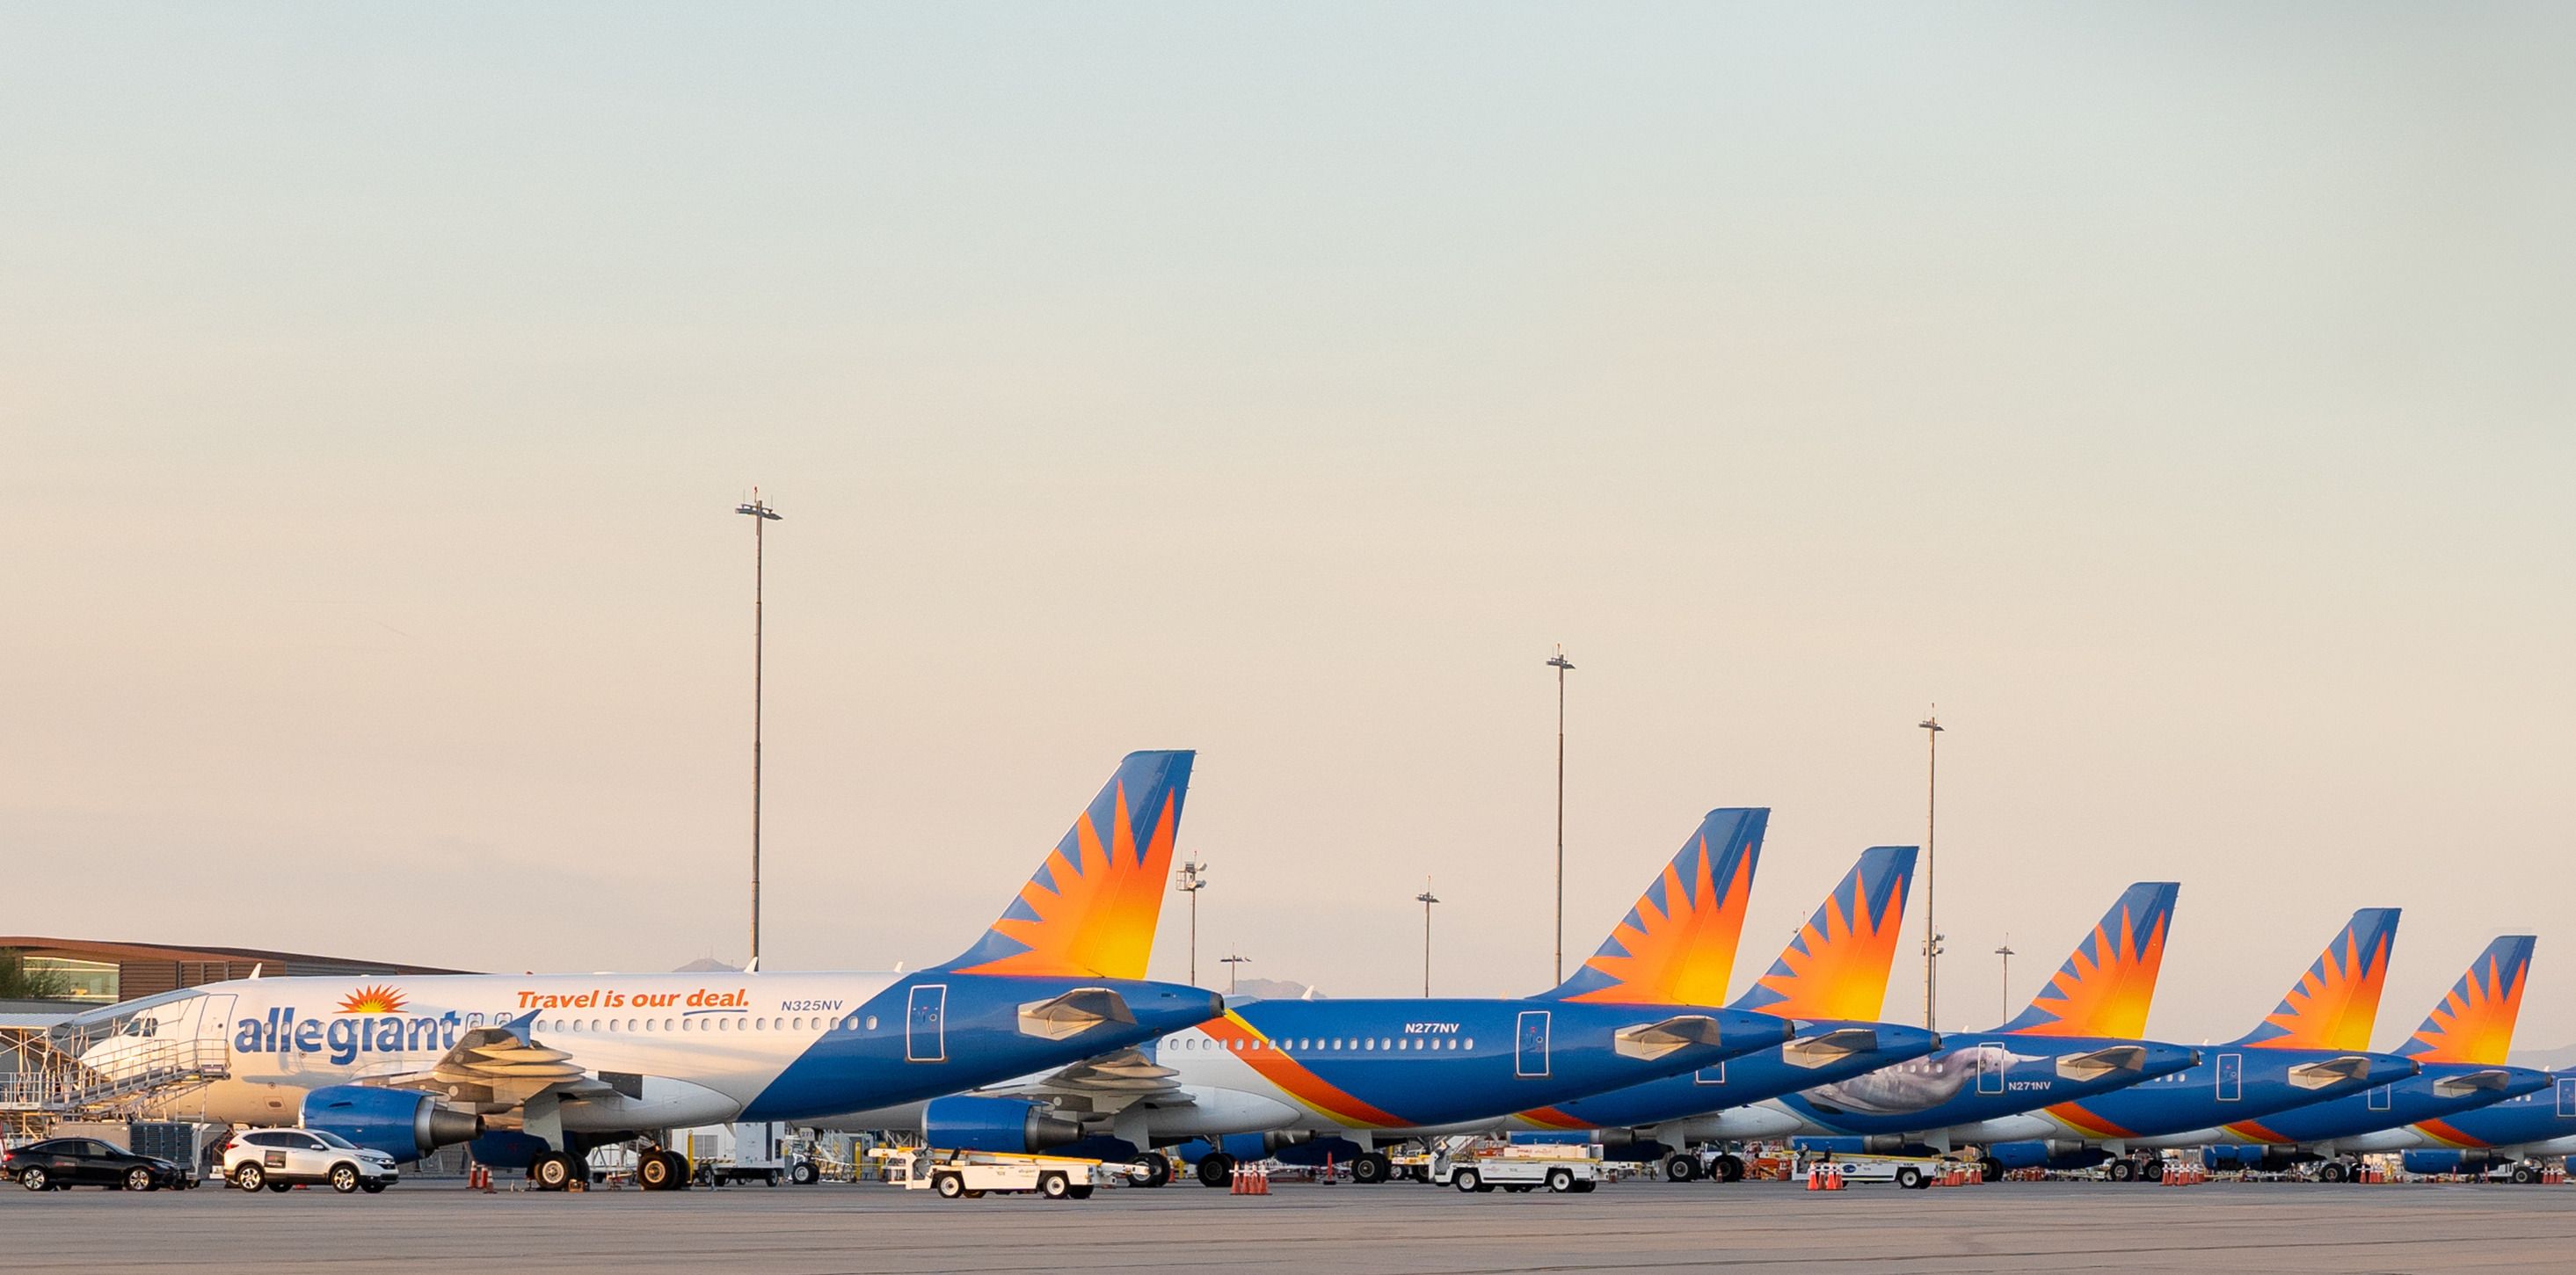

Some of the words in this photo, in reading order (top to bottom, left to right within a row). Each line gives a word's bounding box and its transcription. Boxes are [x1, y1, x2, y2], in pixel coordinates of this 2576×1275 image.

[518, 990, 600, 1009] Travel
[604, 990, 624, 1008] is
[631, 994, 680, 1008] our
[687, 988, 749, 1008] deal.
[781, 1000, 843, 1011] N325NV
[1405, 1023, 1459, 1033] N277NV
[235, 1007, 461, 1065] allegiant
[2008, 1082, 2051, 1090] N271NV
